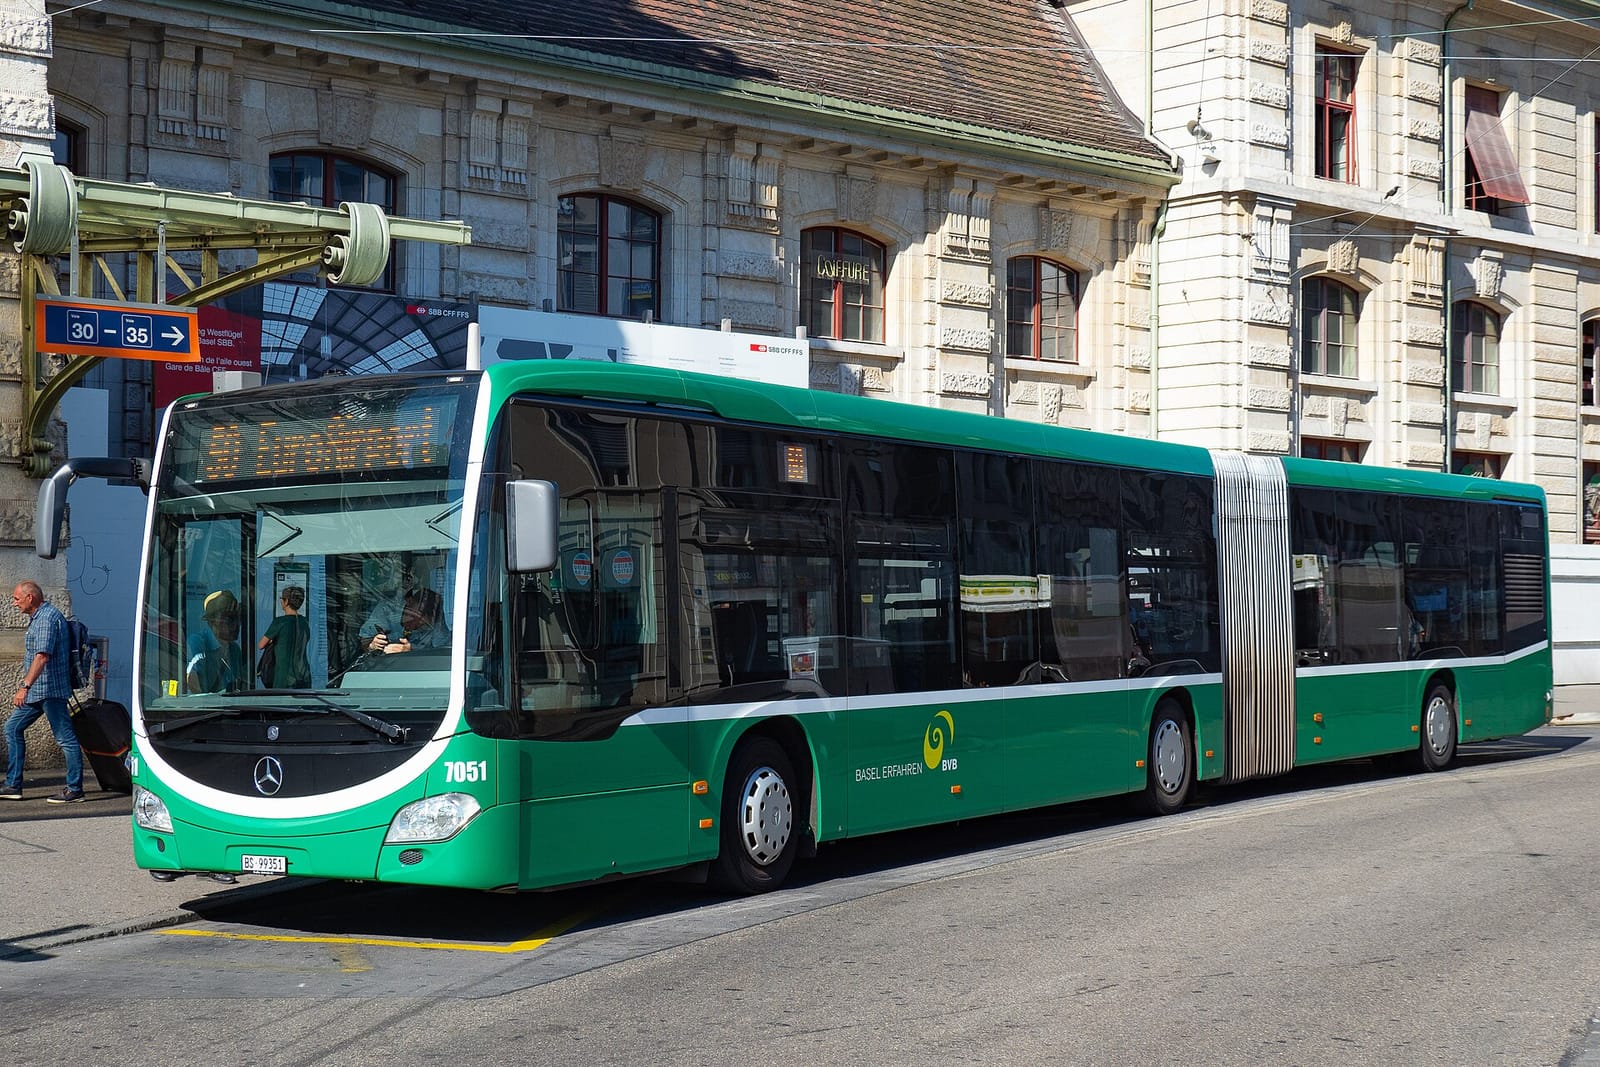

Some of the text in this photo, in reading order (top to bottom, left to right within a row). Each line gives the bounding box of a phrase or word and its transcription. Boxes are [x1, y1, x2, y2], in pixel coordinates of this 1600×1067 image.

[443, 309, 455, 317] CFF
[457, 311, 469, 319] FFS
[72, 323, 94, 340] 30
[126, 327, 148, 344] 35
[207, 328, 243, 340] Westflügel
[165, 362, 182, 371] Gare
[184, 362, 193, 371] de
[205, 356, 215, 364] de
[233, 359, 253, 367] ouest
[941, 758, 958, 771] BVB
[443, 760, 487, 783] 7051
[855, 761, 923, 782] BASEL ERFAHREN
[244, 856, 282, 870] BS 99351
